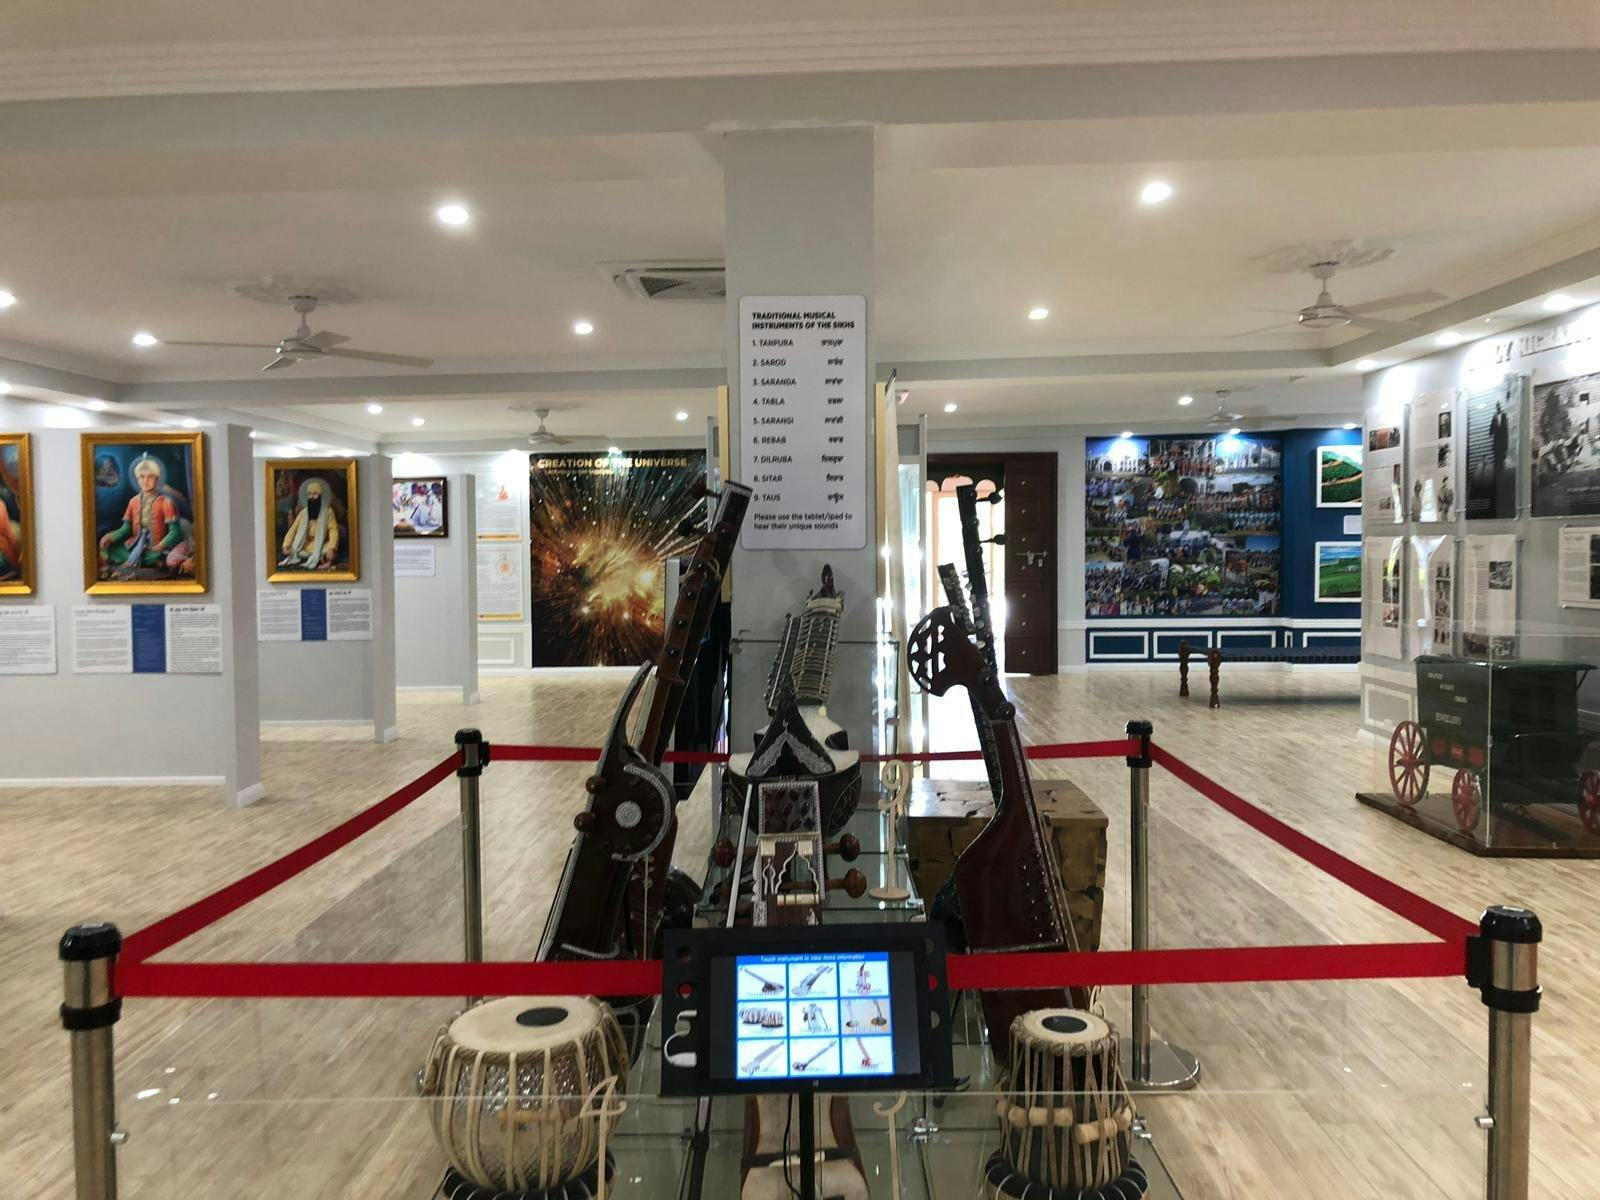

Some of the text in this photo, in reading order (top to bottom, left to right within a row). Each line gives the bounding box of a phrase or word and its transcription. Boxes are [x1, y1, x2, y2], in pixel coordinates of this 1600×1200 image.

[752, 312, 836, 320] TRADITIONAL MUSICAL
[752, 320, 855, 330] INSTRUMENTS OF THE SIKHS
[759, 339, 794, 347] TANPURA
[760, 359, 787, 367] SAROD
[761, 378, 797, 386] SARANDA
[762, 397, 785, 405] TABLA
[761, 416, 794, 424] SARANGI
[761, 436, 786, 444] REBAB
[537, 458, 593, 469] CREATION
[594, 457, 609, 468] OF
[634, 457, 688, 468] UNIVERSE
[760, 455, 793, 463] DILRUBA
[761, 474, 783, 482] SITAR
[762, 494, 781, 502] TAUS
[753, 513, 776, 521] Please
[771, 522, 787, 530] their
[788, 523, 812, 531] unique
[814, 522, 838, 530] sounds
